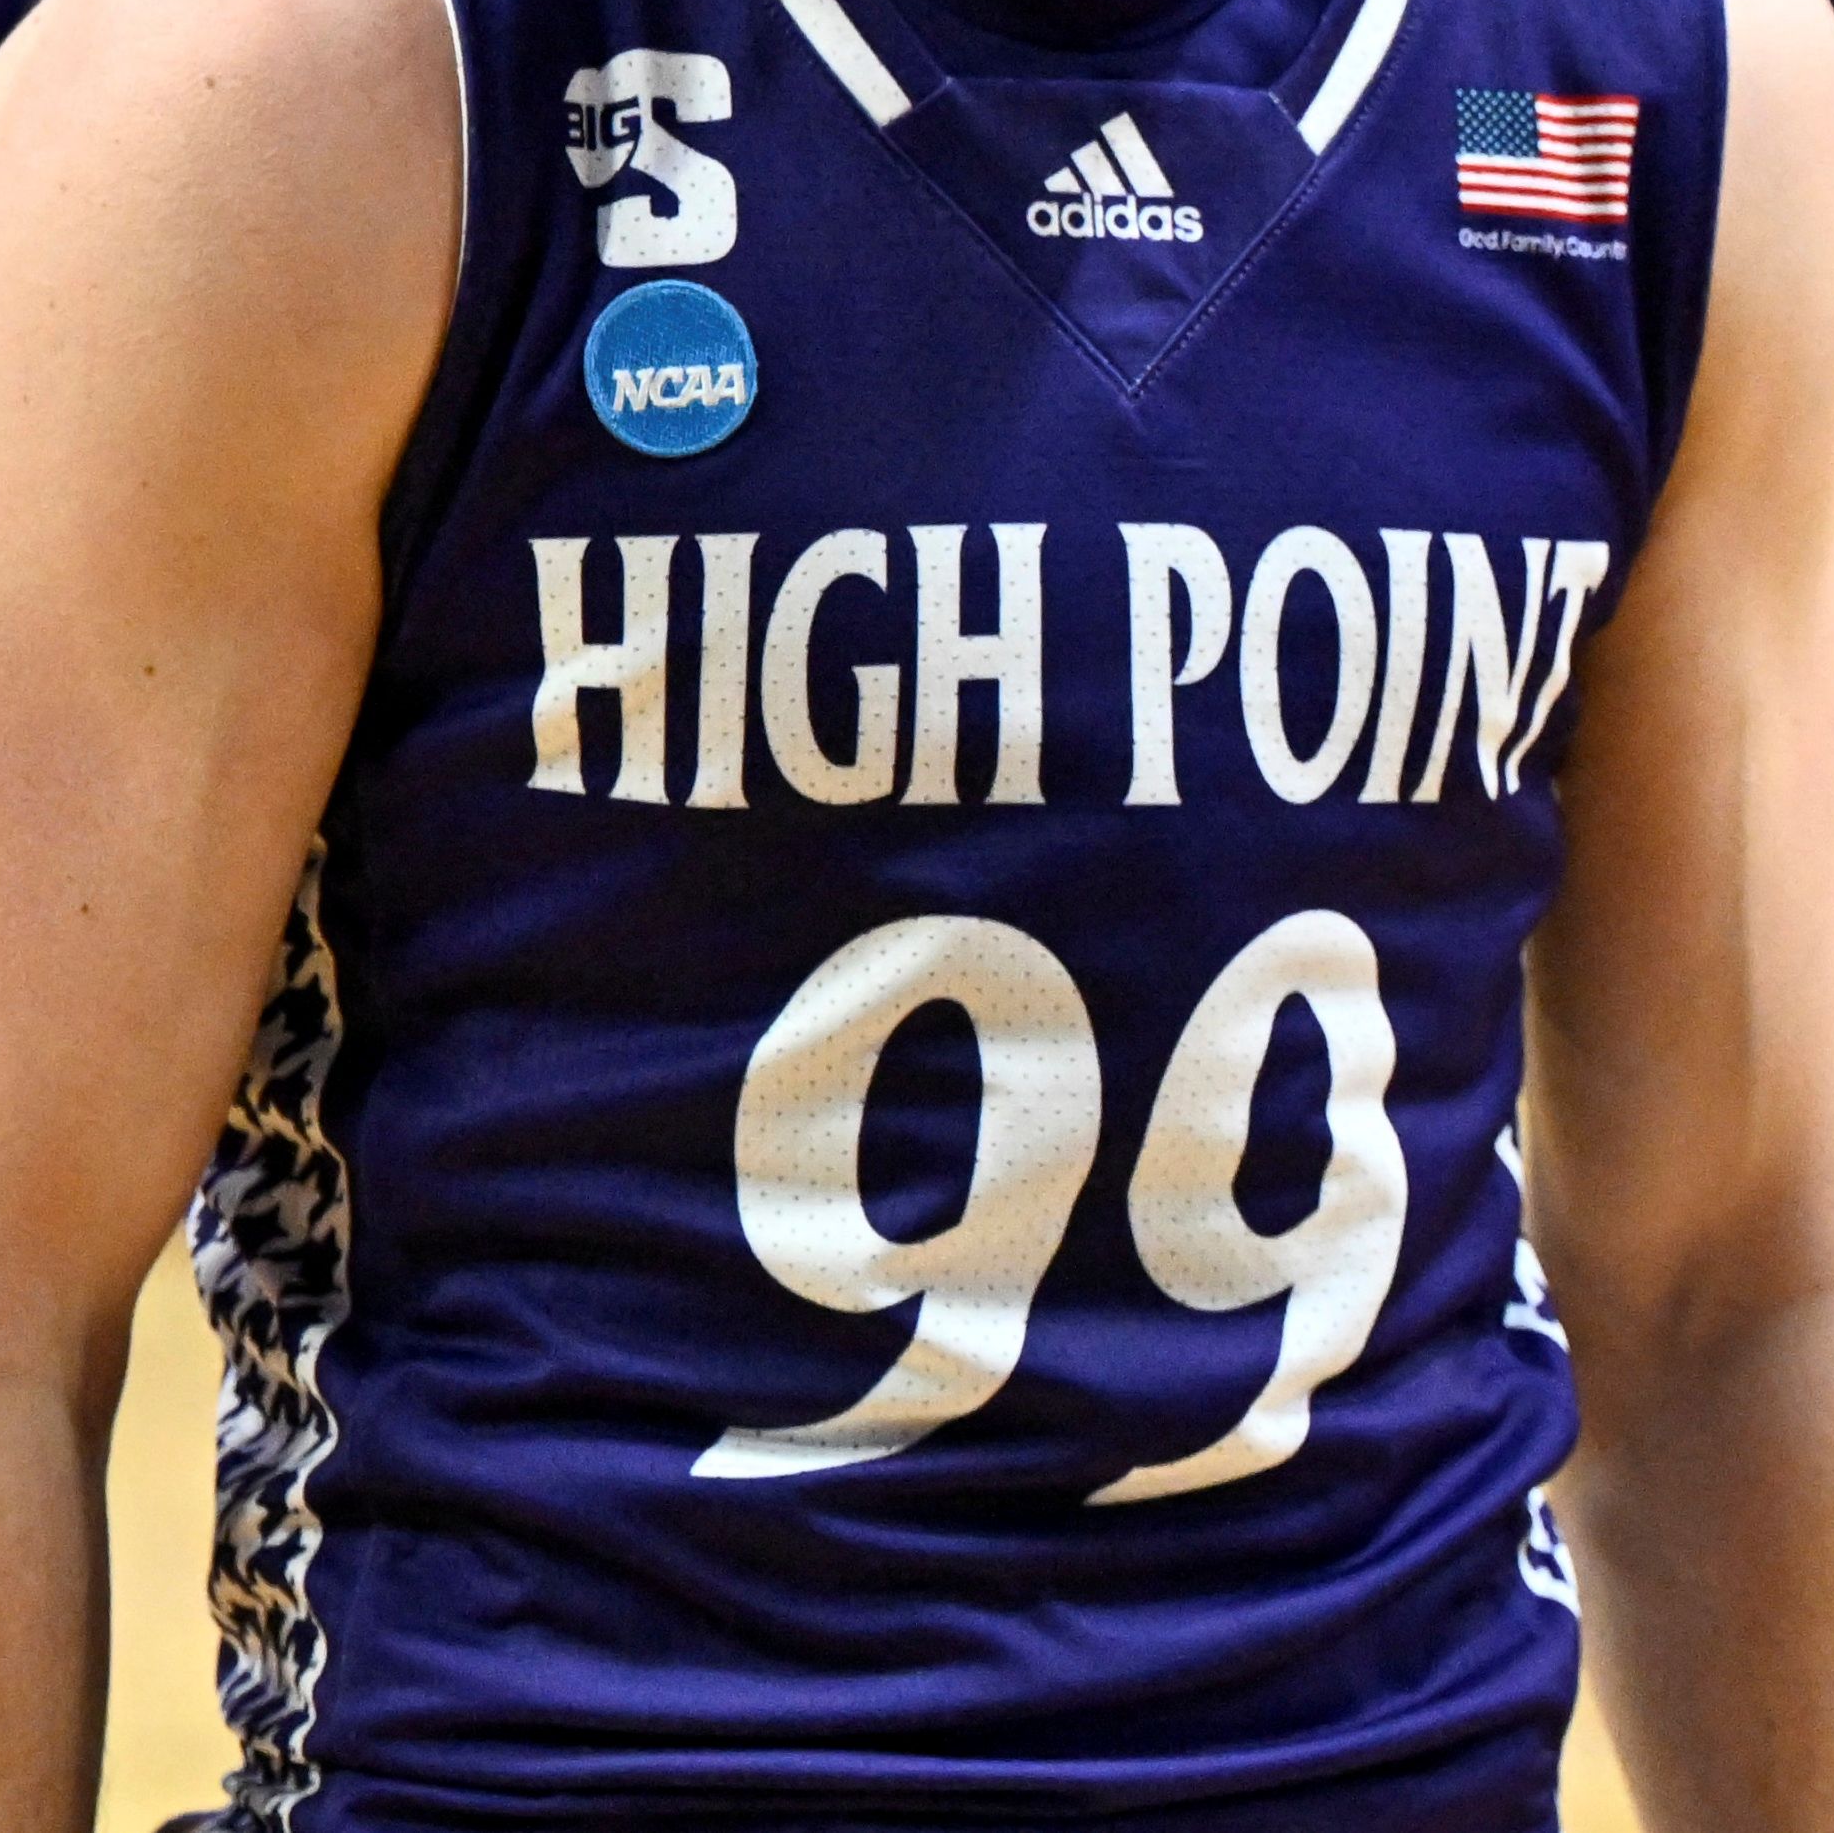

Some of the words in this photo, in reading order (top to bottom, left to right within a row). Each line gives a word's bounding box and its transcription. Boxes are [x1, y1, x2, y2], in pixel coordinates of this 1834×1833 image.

[1025, 190, 1205, 243] adidas
[612, 363, 748, 413] NCAA
[526, 520, 1049, 810] HIGH
[1116, 521, 1611, 807] POINT
[689, 908, 1409, 1507] 99
